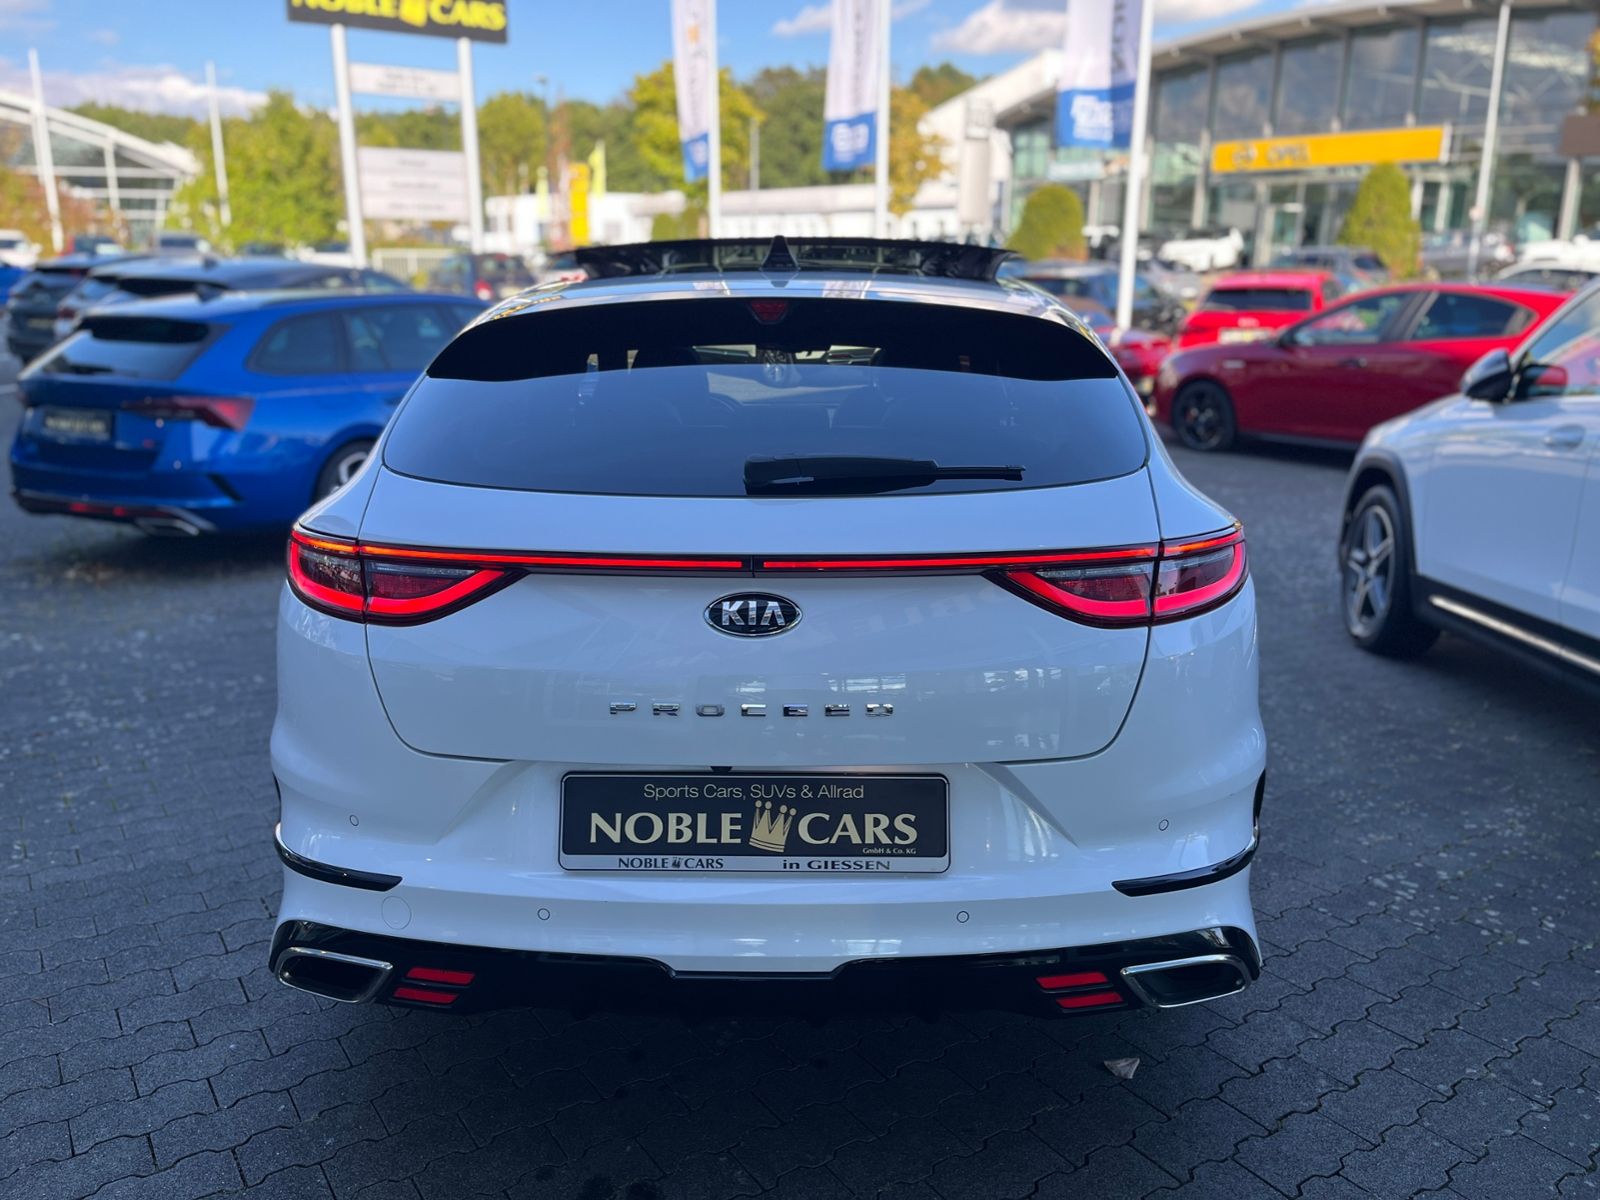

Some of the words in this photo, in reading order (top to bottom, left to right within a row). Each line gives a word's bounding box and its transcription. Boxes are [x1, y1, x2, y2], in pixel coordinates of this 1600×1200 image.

[429, 0, 507, 31] CARS
[721, 600, 786, 626] KIA
[609, 702, 894, 717] PROCEED
[643, 783, 699, 801] Sports
[703, 783, 746, 800] Cars,
[750, 784, 796, 799] SUVs
[800, 784, 814, 799] &
[817, 784, 864, 799] Allrad
[589, 812, 742, 844] NOBLE
[797, 812, 918, 845] CARS
[892, 847, 905, 855] Co.
[618, 857, 669, 869] NOBLE
[684, 857, 724, 869] CARS
[782, 859, 800, 870] in
[807, 860, 891, 871] GIESSEN
